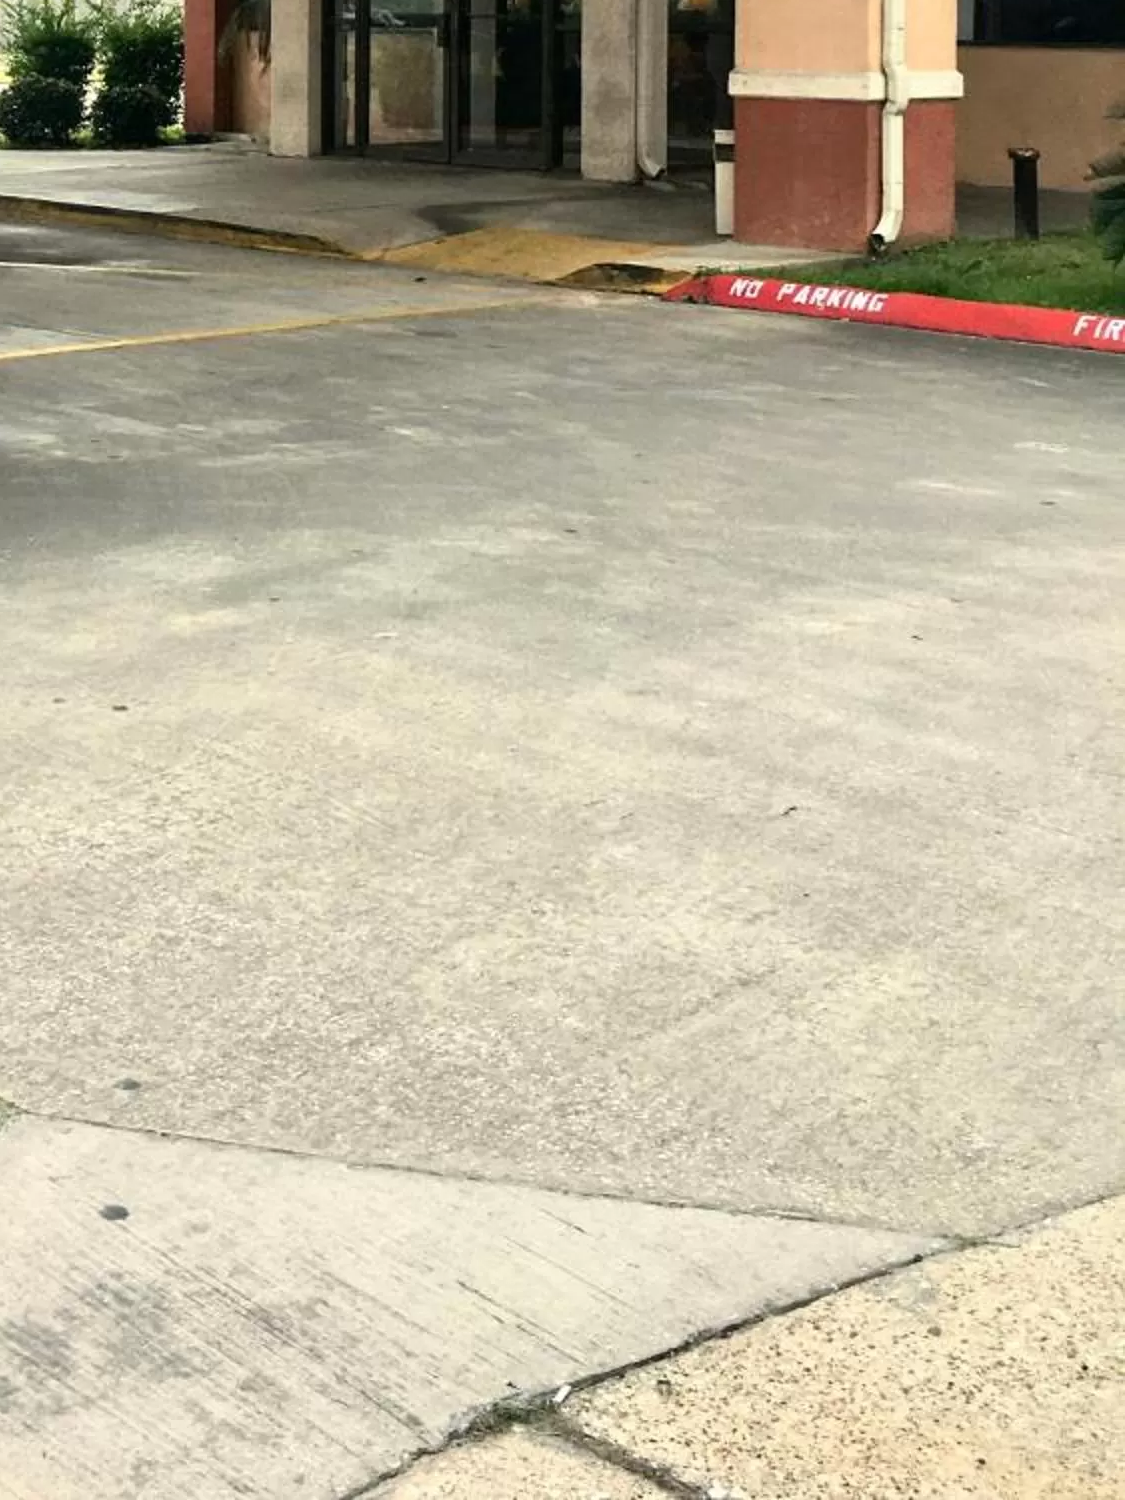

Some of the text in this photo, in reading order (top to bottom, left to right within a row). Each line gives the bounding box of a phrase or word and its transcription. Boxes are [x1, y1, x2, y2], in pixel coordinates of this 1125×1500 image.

[729, 278, 889, 312] NO PARKING
[1073, 315, 1125, 341] FIR
